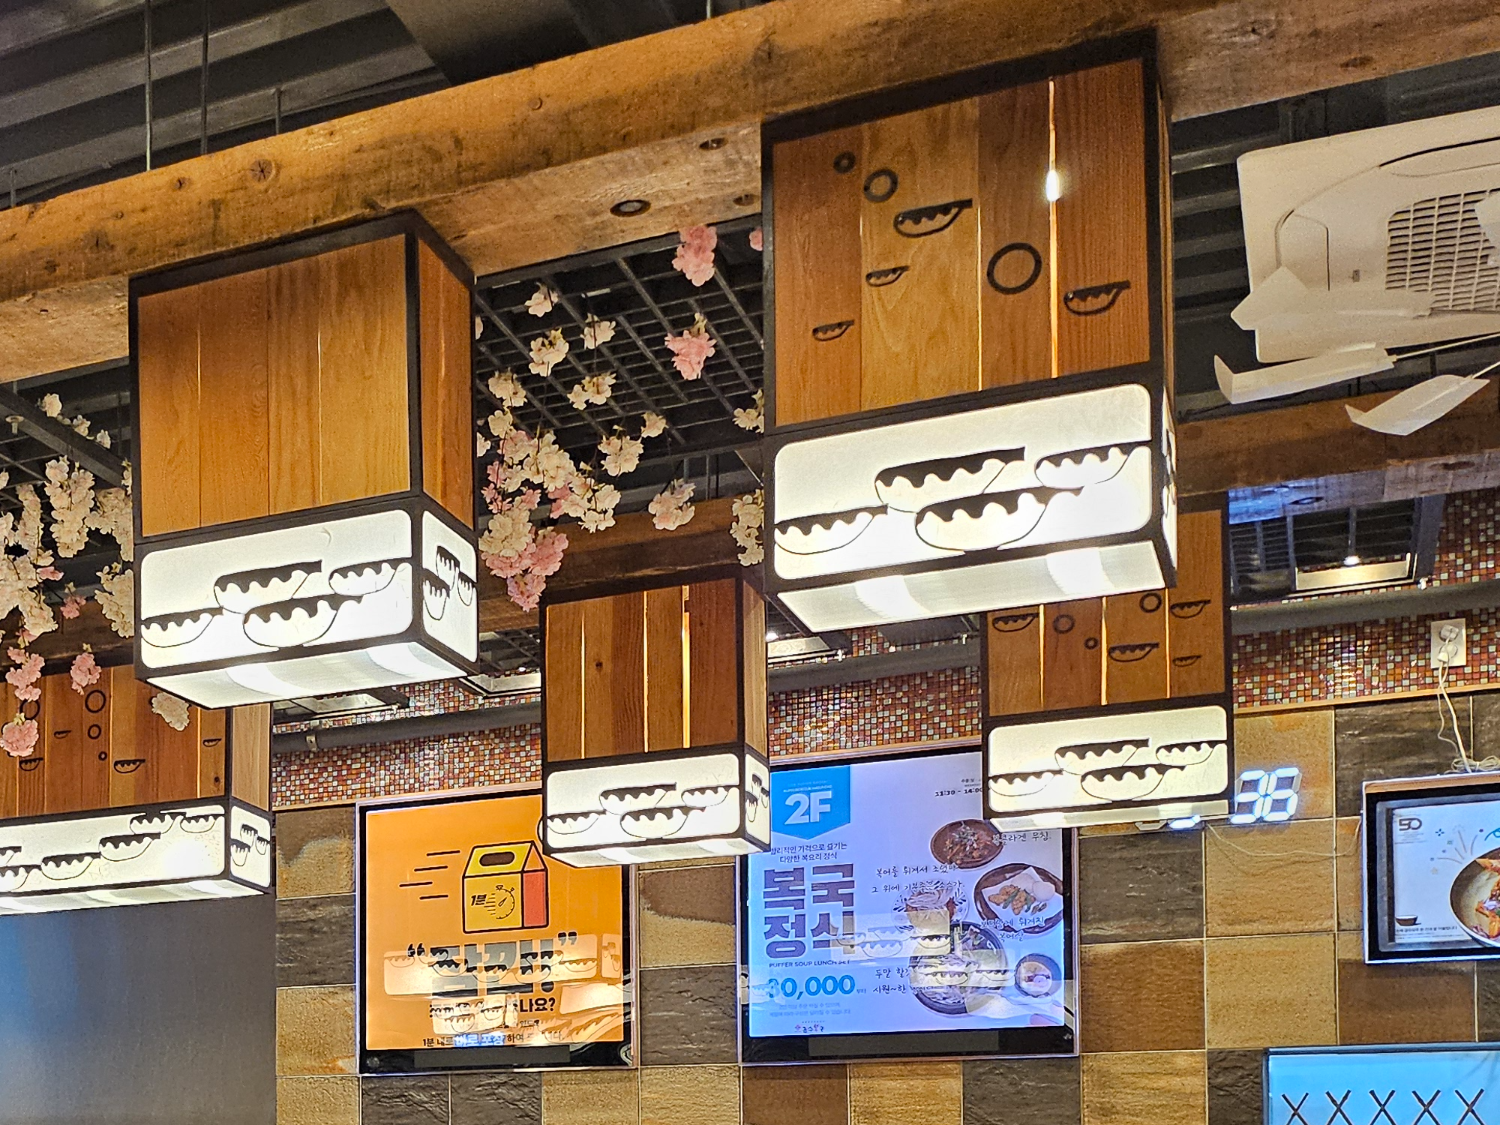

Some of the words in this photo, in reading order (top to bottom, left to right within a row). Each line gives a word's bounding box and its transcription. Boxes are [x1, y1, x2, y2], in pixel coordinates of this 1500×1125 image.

[784, 790, 832, 825] 2F
[763, 864, 855, 909] 복국
[763, 910, 856, 959] 정식
